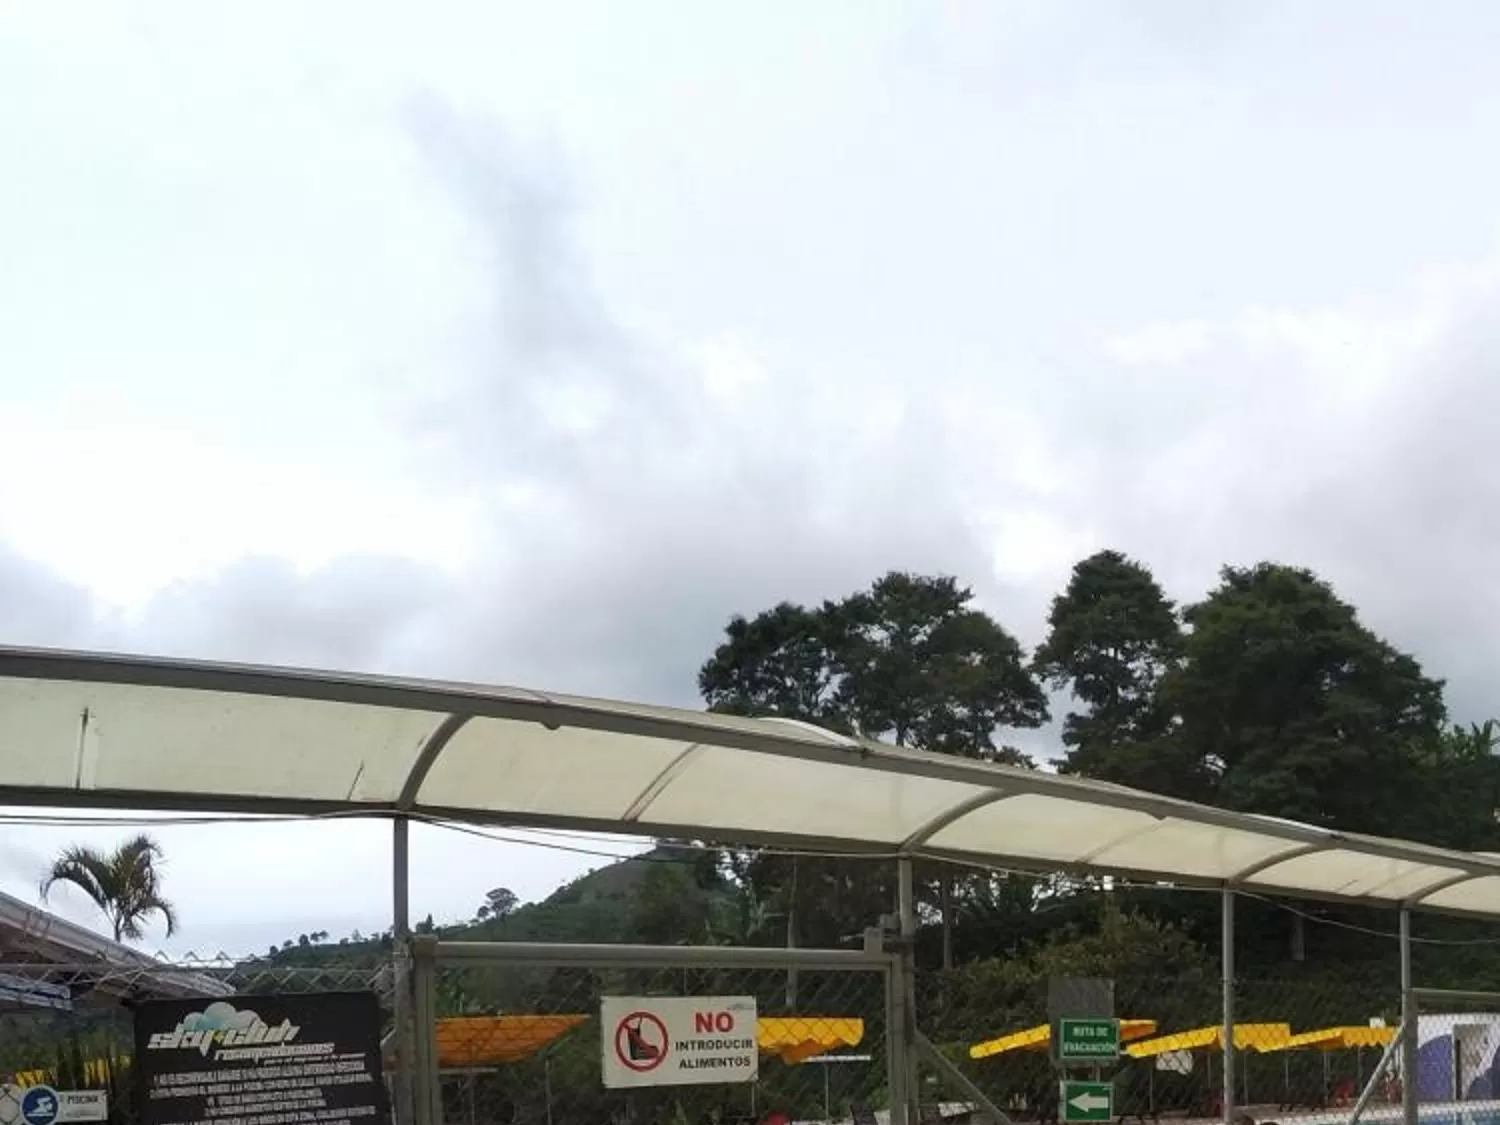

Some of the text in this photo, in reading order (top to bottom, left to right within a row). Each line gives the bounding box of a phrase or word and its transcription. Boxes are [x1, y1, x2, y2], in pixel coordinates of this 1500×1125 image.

[695, 1012, 733, 1032] NO
[675, 1039, 753, 1052] INTRODUCIR
[679, 1056, 750, 1069] ALIMENTOS
